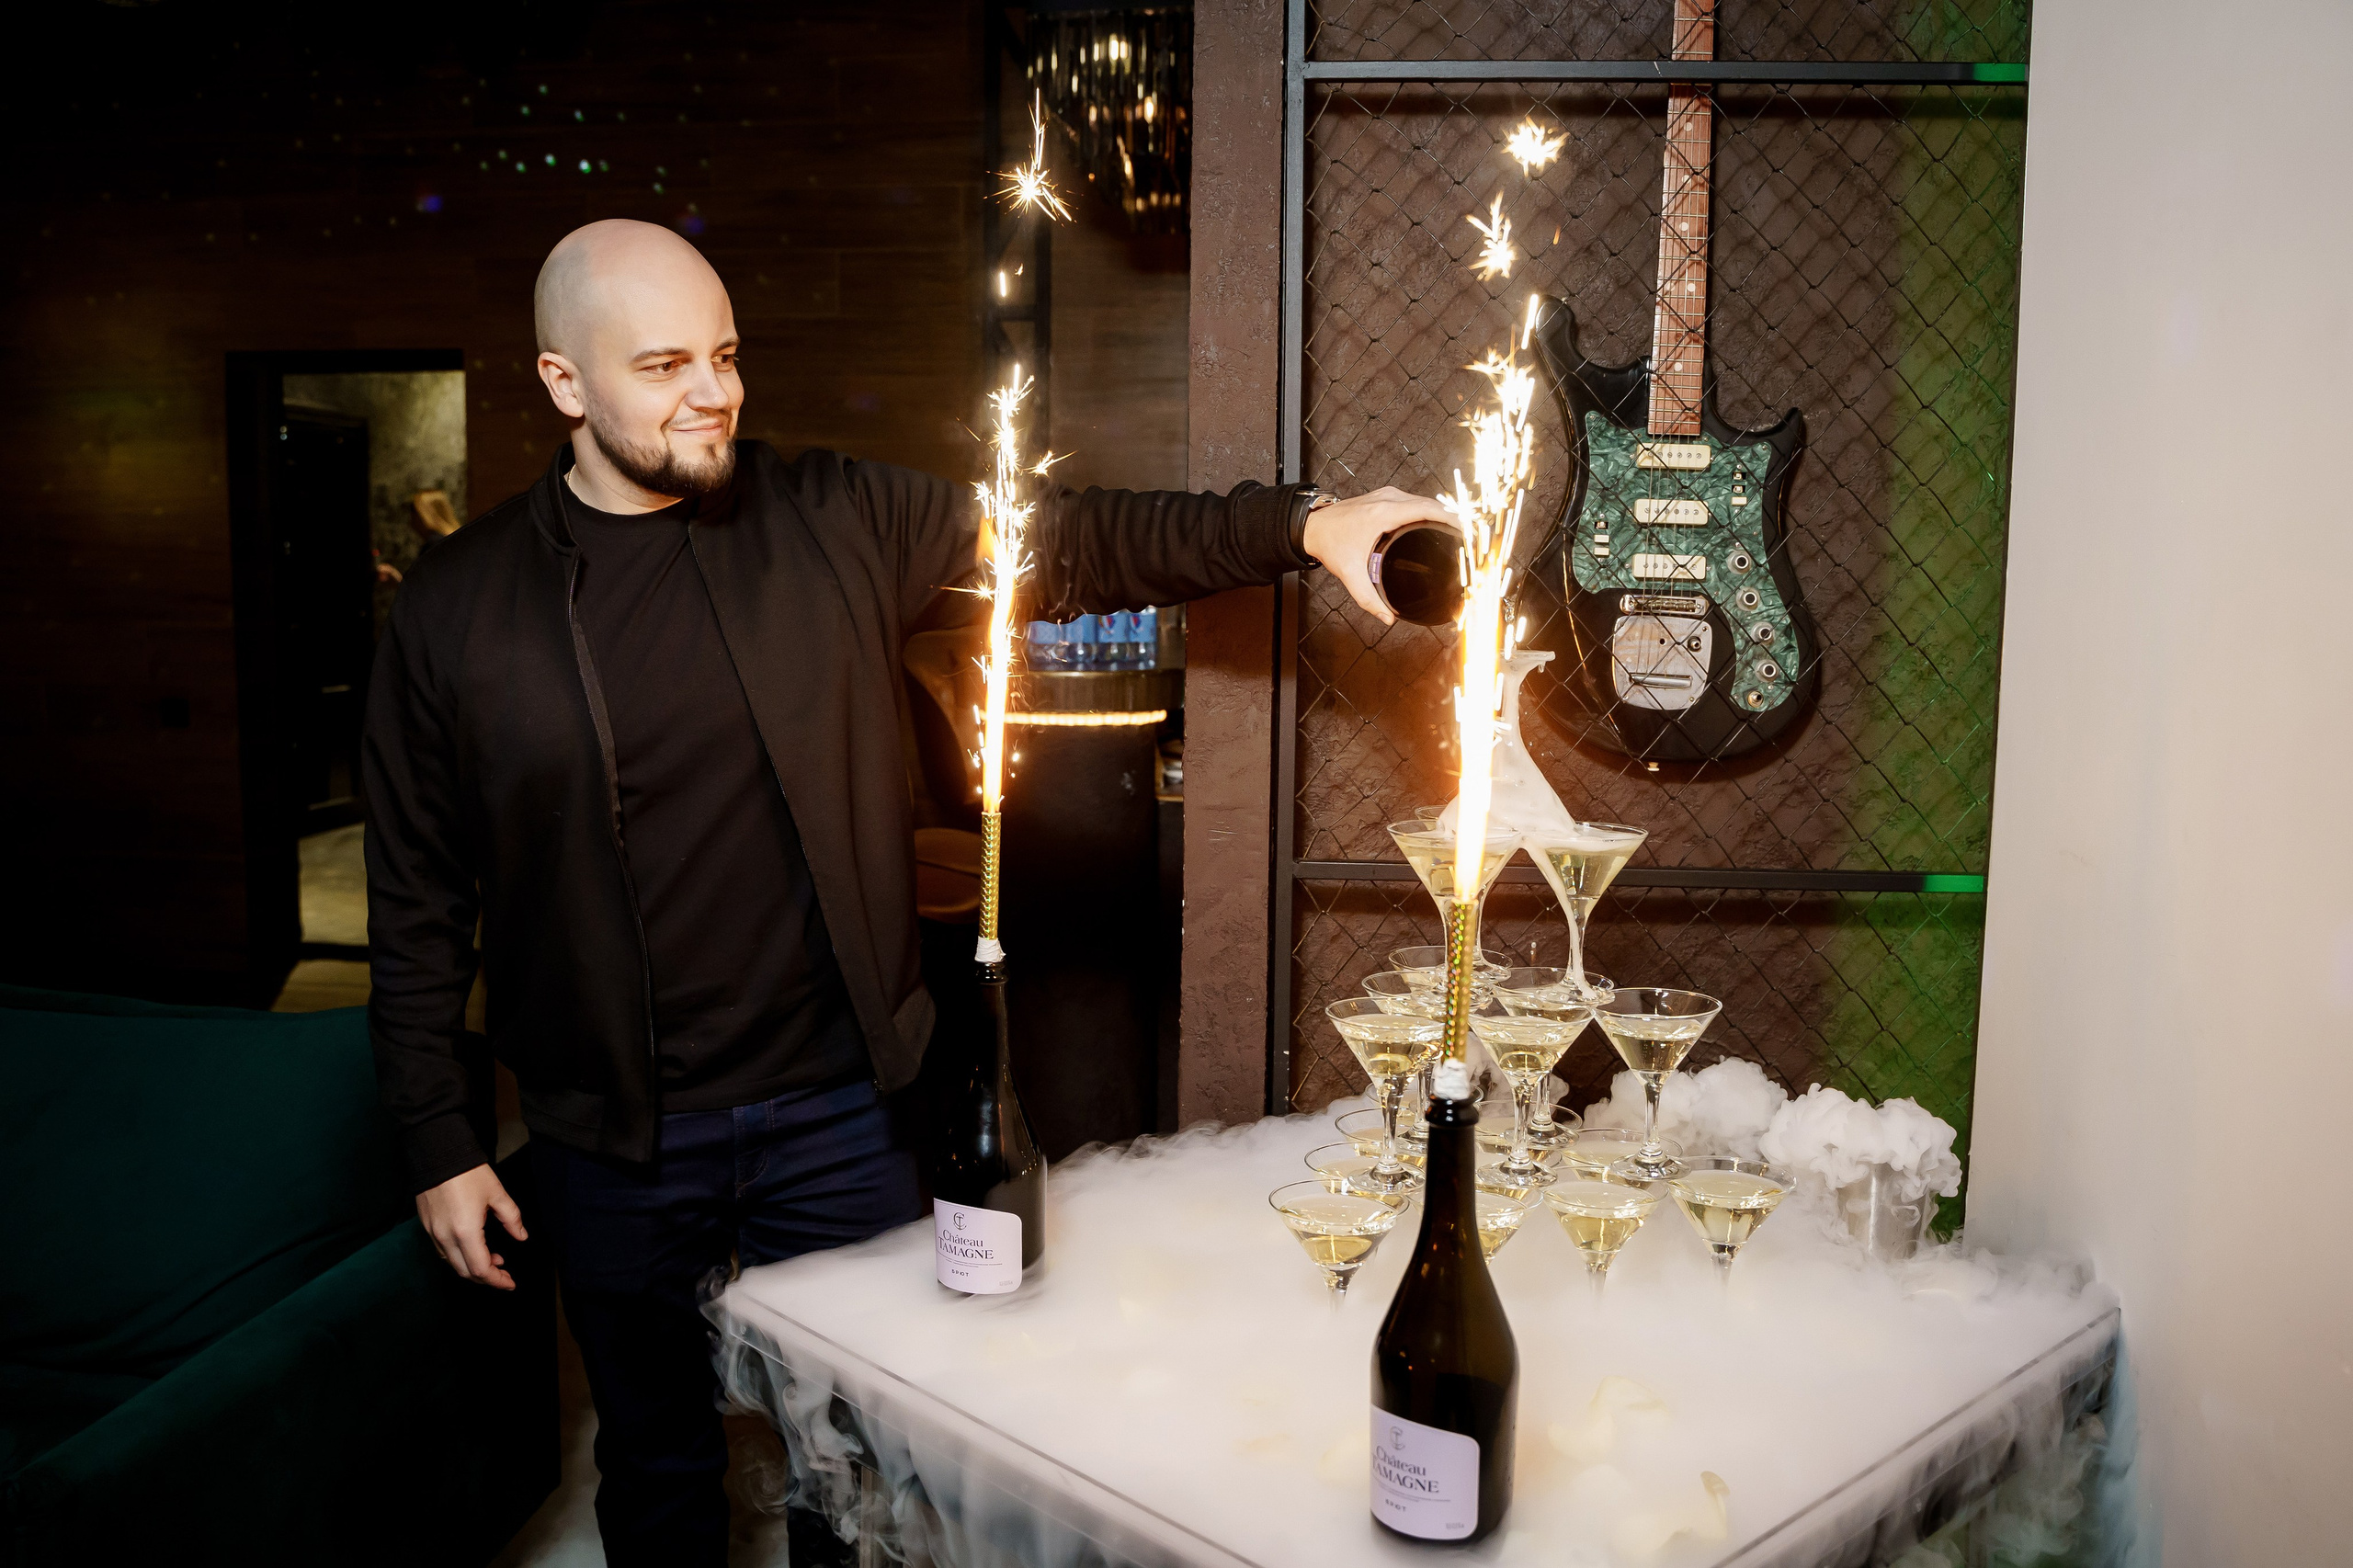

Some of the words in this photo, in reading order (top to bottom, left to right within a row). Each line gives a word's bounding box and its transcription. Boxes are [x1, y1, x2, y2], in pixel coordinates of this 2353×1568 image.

[938, 1235, 995, 1259] TAMAGNE
[942, 1229, 983, 1247] Château
[1371, 1452, 1439, 1494] TAMAGNE
[1376, 1445, 1427, 1476] Château
